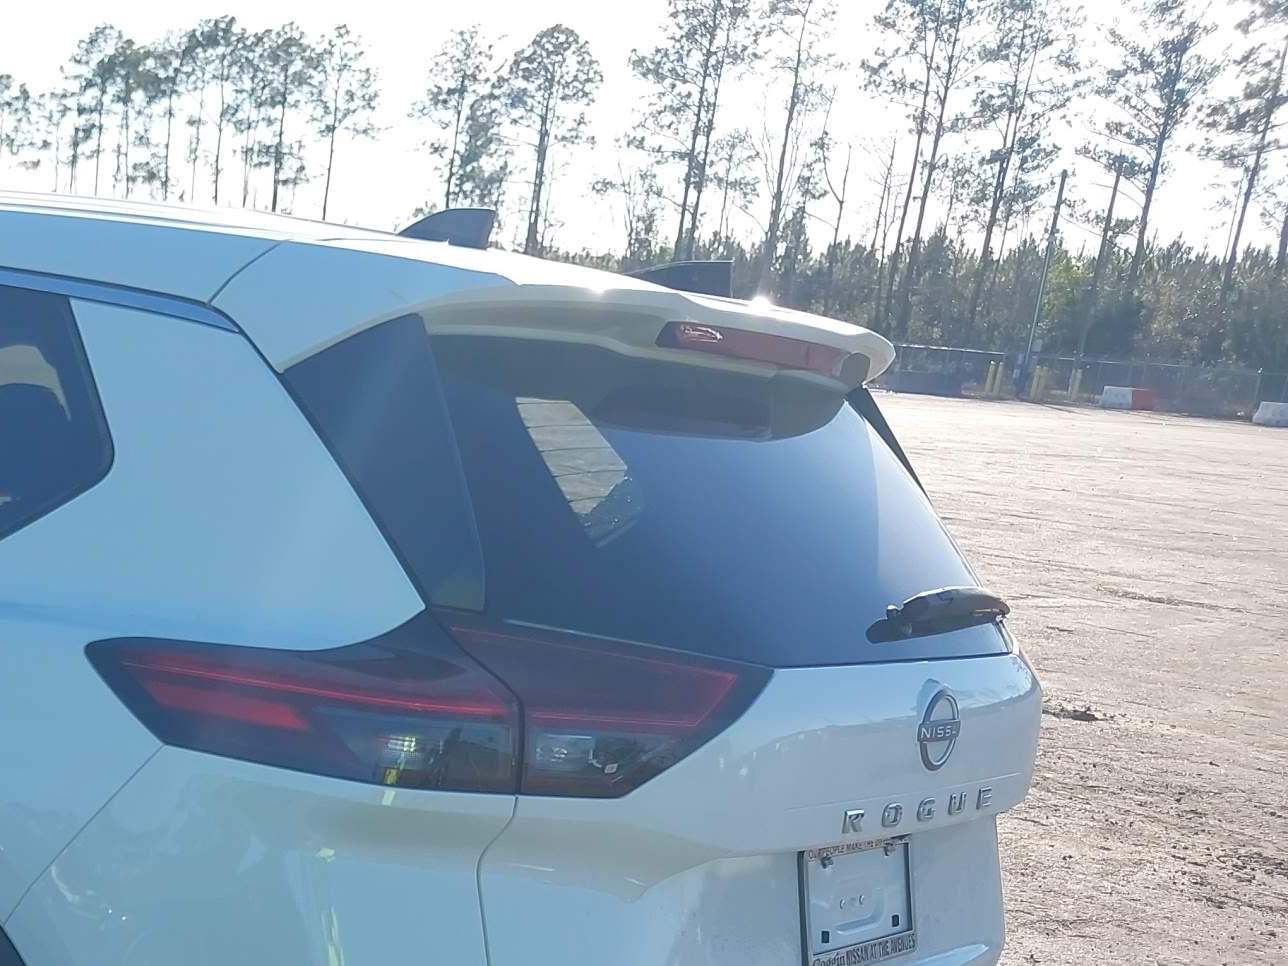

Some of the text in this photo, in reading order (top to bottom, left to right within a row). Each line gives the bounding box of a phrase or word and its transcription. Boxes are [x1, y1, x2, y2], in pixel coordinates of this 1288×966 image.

[841, 786, 993, 833] ROGUE
[846, 944, 869, 966] NISSAN
[870, 943, 879, 960] AT
[879, 940, 890, 958] THE
[891, 932, 916, 955] AVENUES
